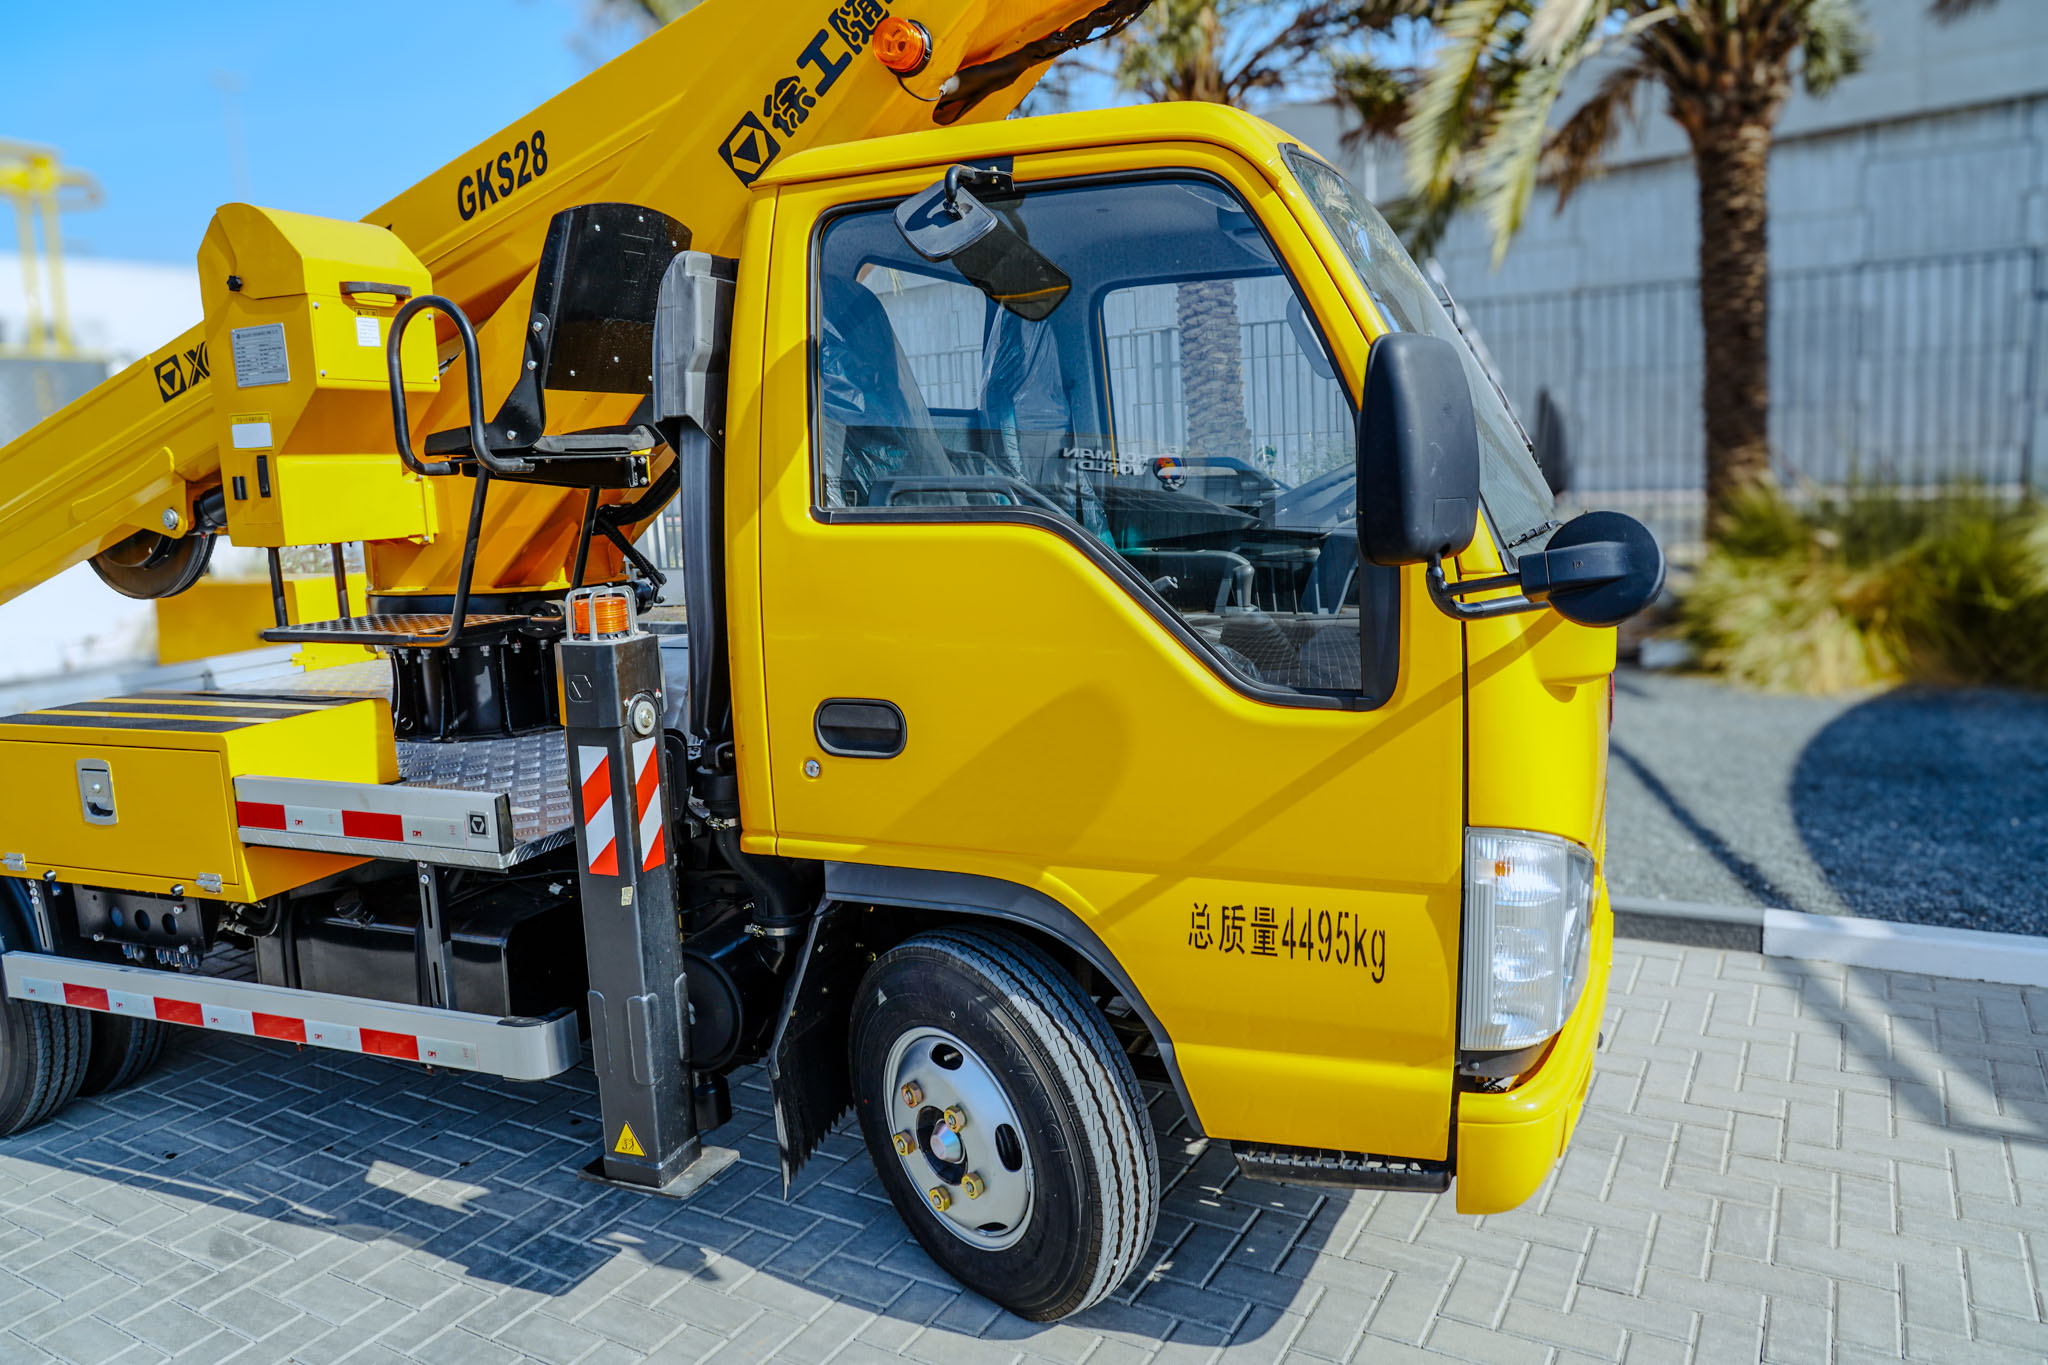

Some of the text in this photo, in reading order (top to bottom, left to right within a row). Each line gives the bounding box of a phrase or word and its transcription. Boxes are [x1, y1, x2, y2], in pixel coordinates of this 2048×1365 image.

[457, 130, 548, 221] GKS28
[1187, 902, 1386, 984] 总质量4495kg
